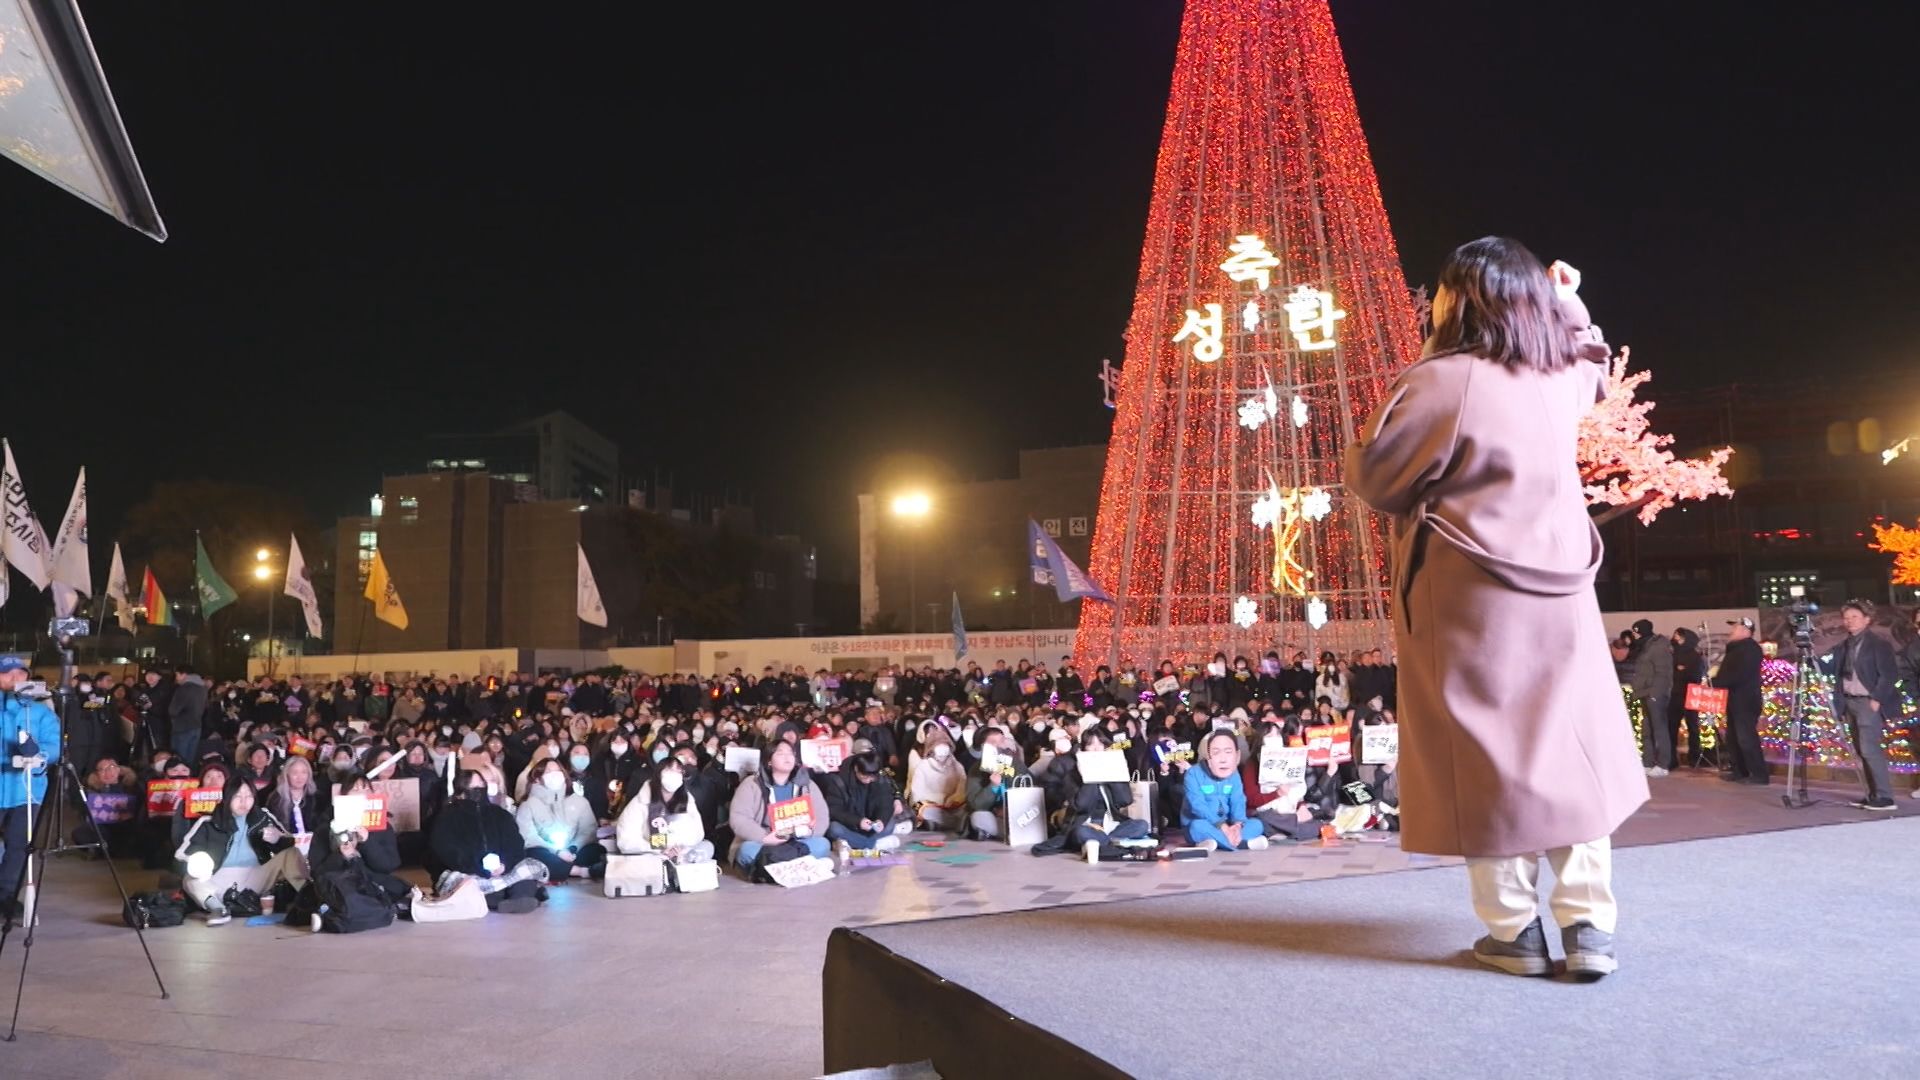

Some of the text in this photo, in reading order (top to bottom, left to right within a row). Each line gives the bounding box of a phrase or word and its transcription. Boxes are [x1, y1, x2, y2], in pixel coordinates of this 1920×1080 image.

[1219, 235, 1281, 291] 축
[1172, 290, 1346, 362] 성 탄
